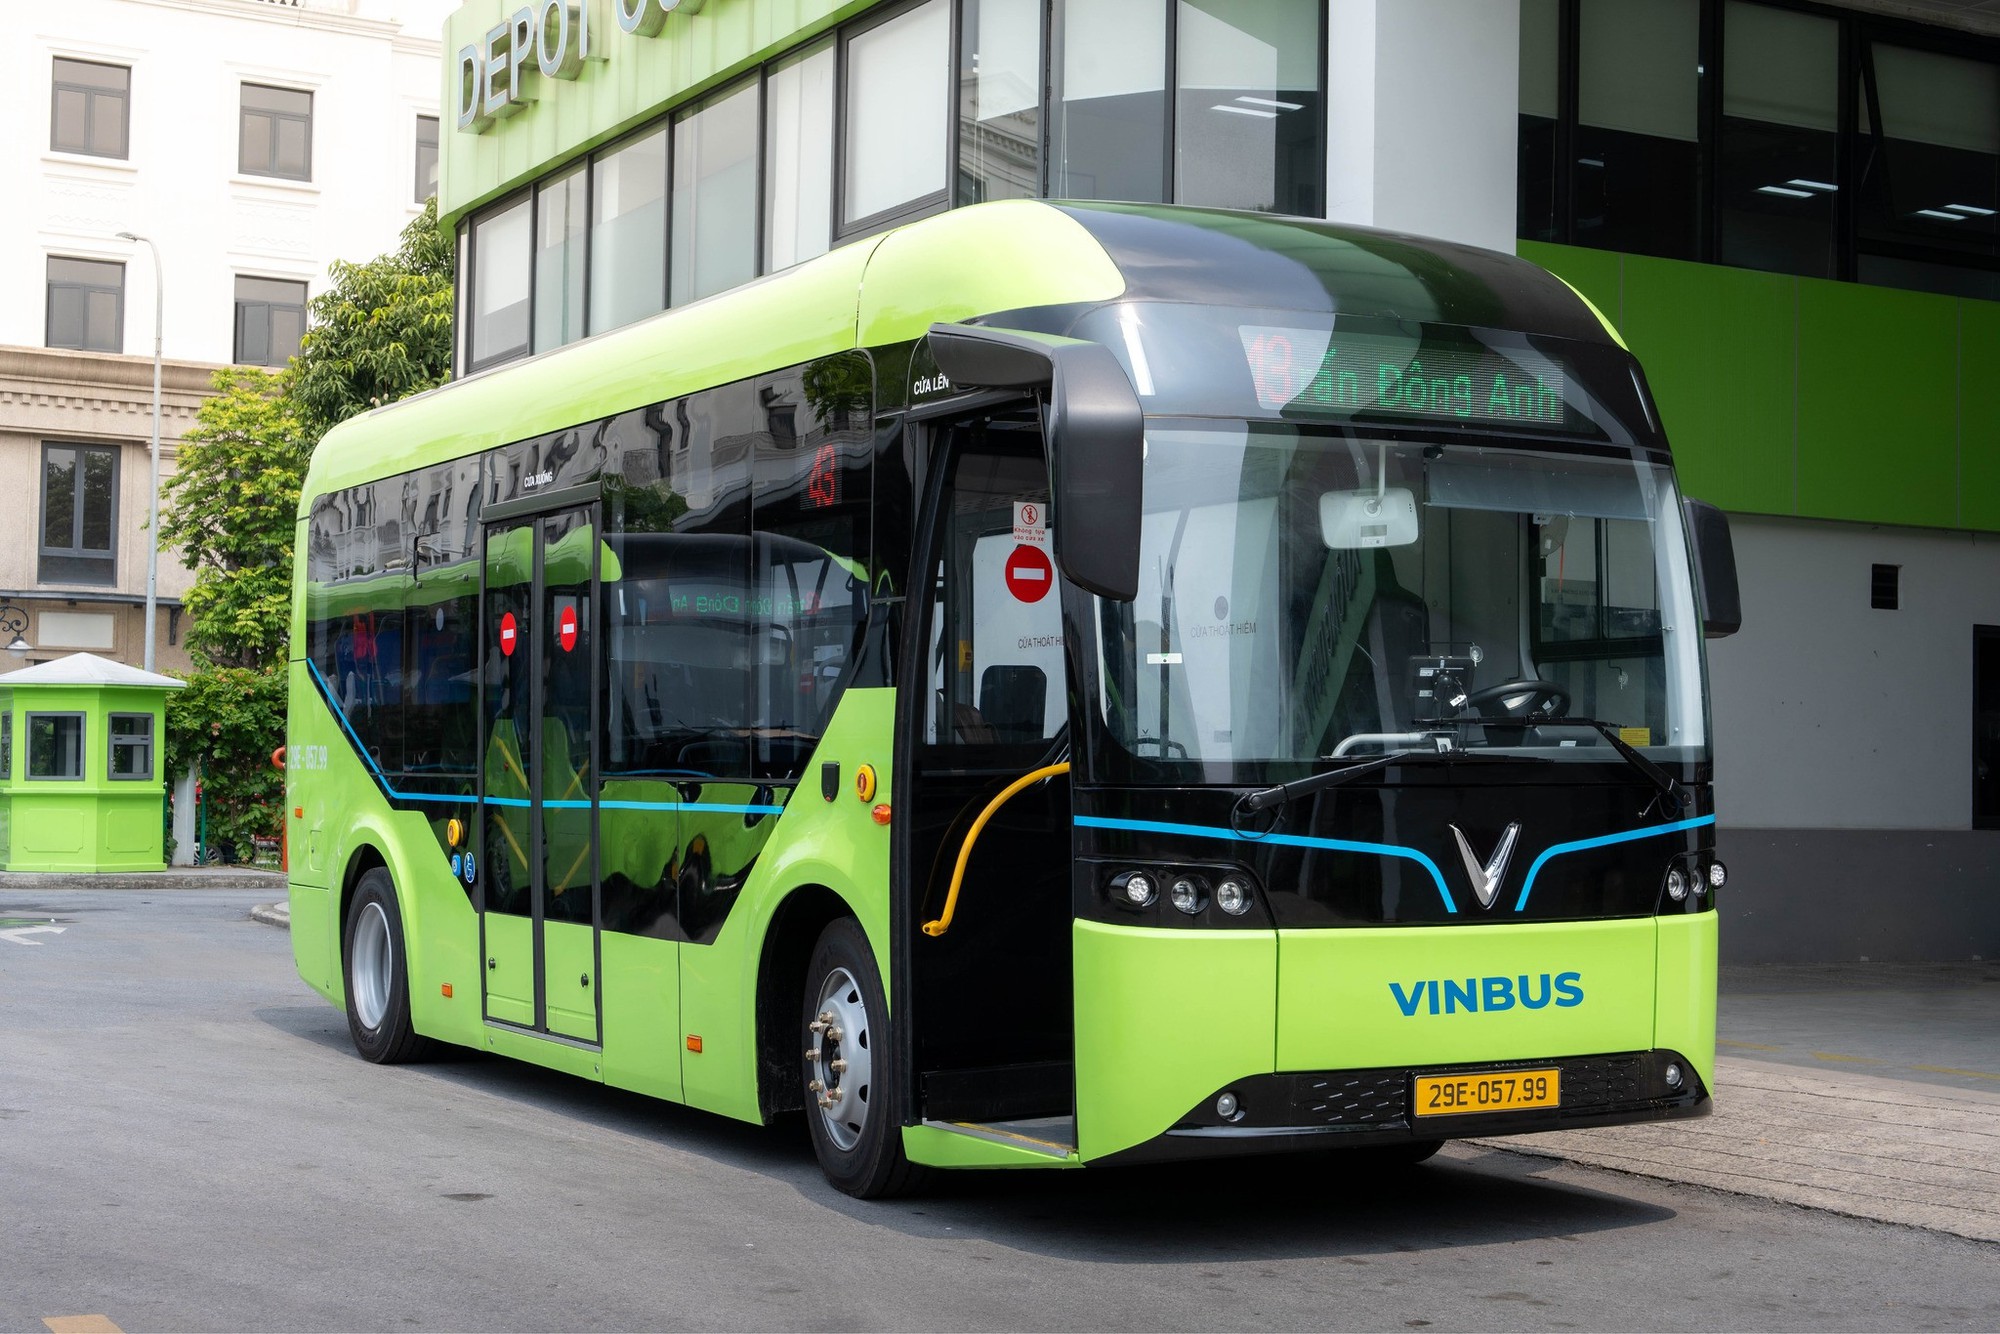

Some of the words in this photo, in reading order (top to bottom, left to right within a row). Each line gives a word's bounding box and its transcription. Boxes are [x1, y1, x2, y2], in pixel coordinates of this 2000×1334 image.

[913, 375, 932, 396] CỬA
[932, 372, 949, 391] LÊN
[1376, 360, 1472, 417] Đông
[1487, 373, 1557, 417] Anh
[808, 443, 836, 507] 43
[1388, 971, 1585, 1017] VINBUS
[1428, 1077, 1548, 1109] 29E-057.99
